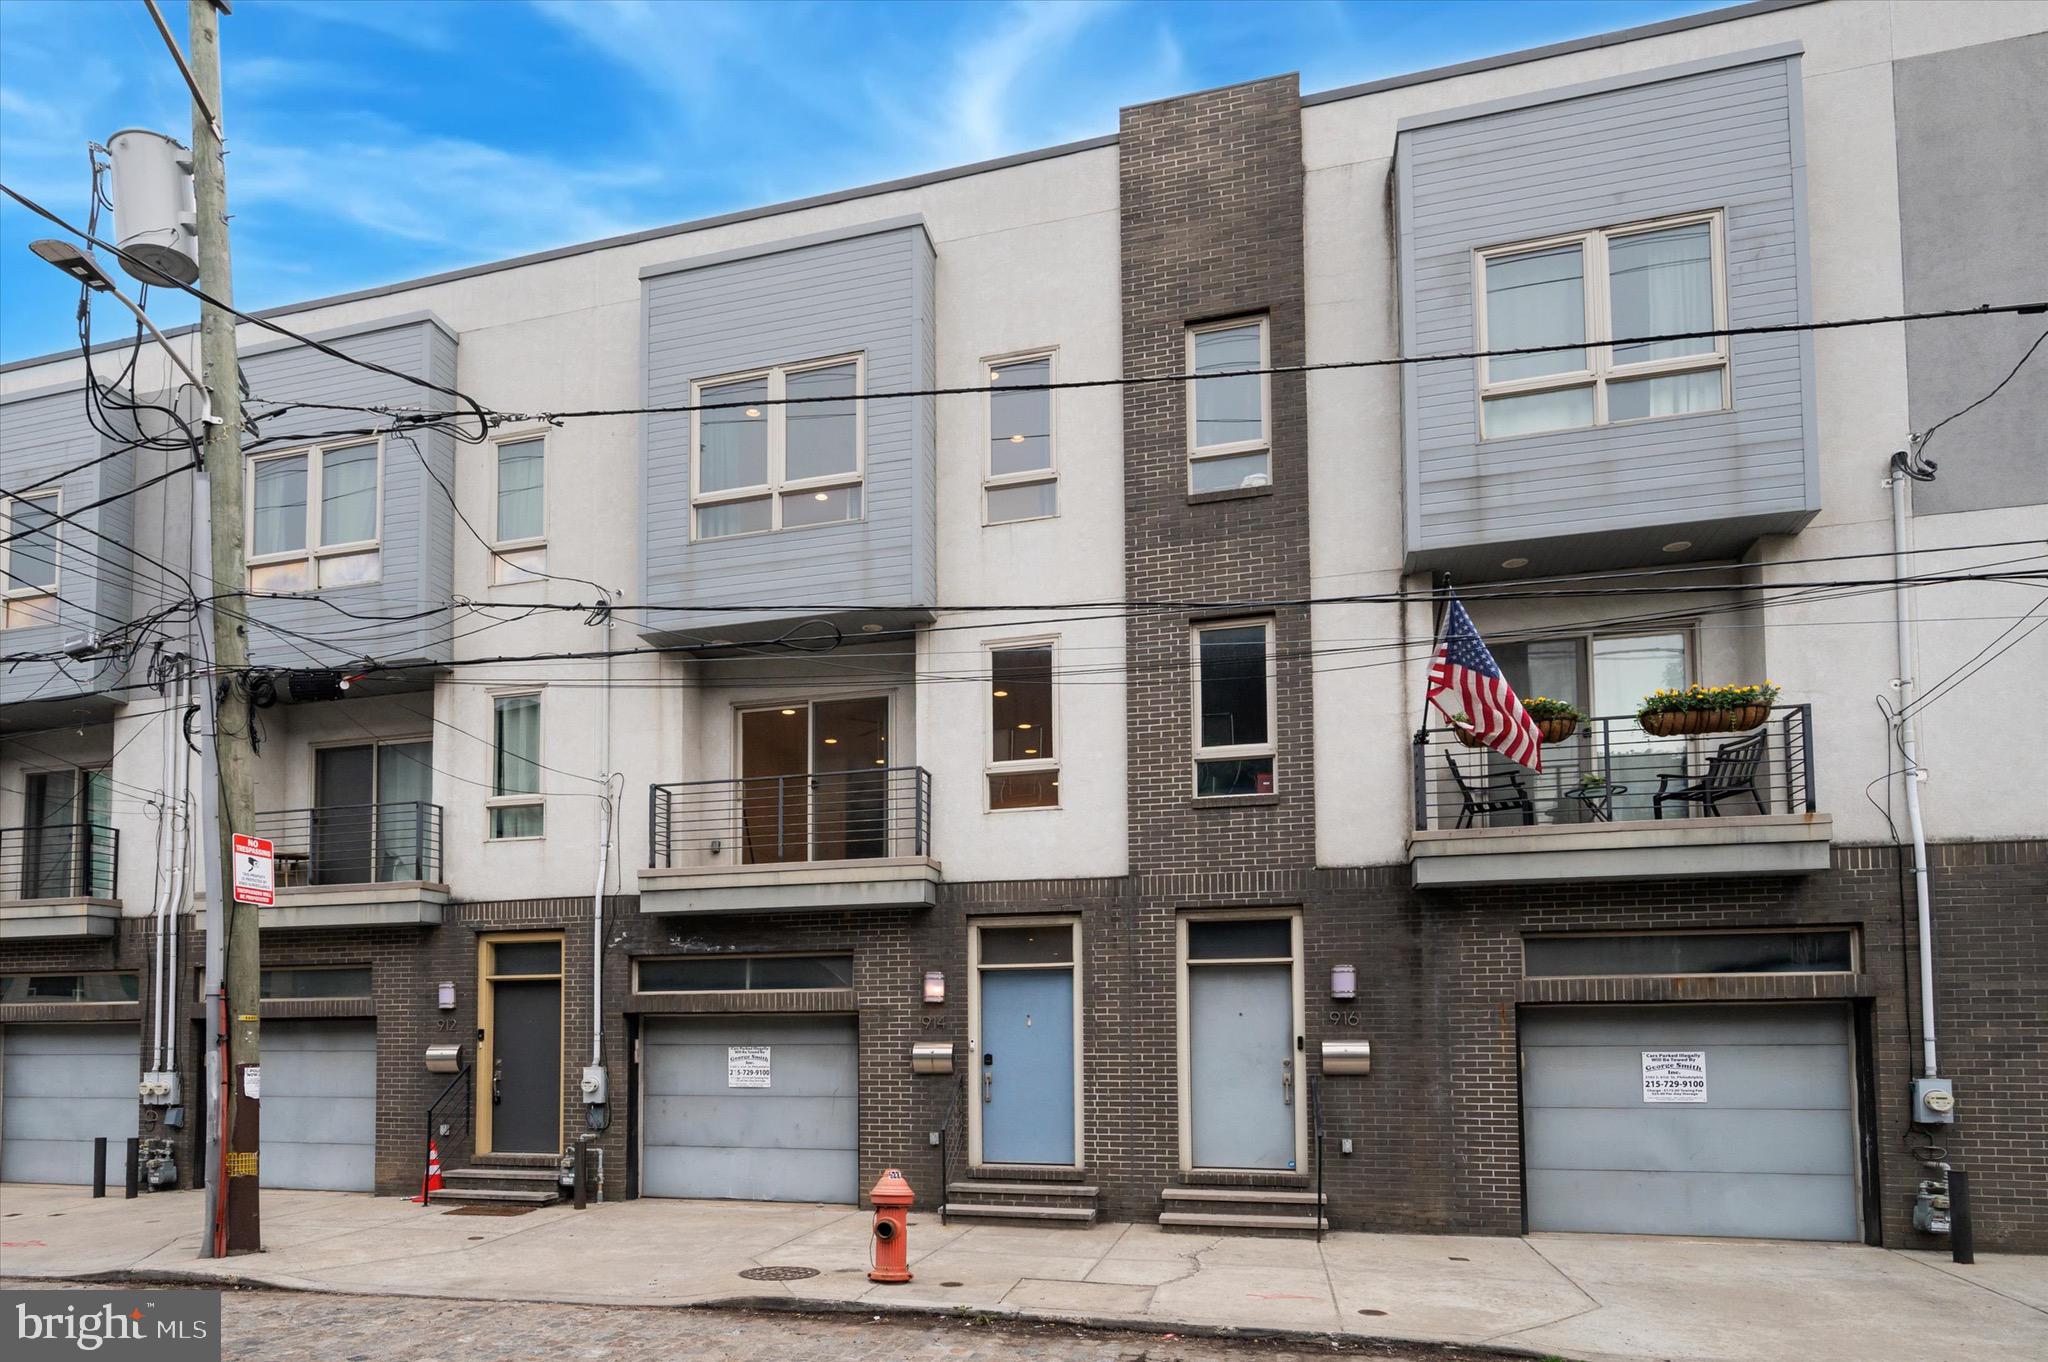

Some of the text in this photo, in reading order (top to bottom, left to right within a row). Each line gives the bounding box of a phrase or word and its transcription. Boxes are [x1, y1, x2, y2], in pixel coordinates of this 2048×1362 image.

[248, 839, 258, 848] NO
[922, 1016, 944, 1029] 914
[1329, 1010, 1359, 1025] 916
[437, 1018, 456, 1031] 912
